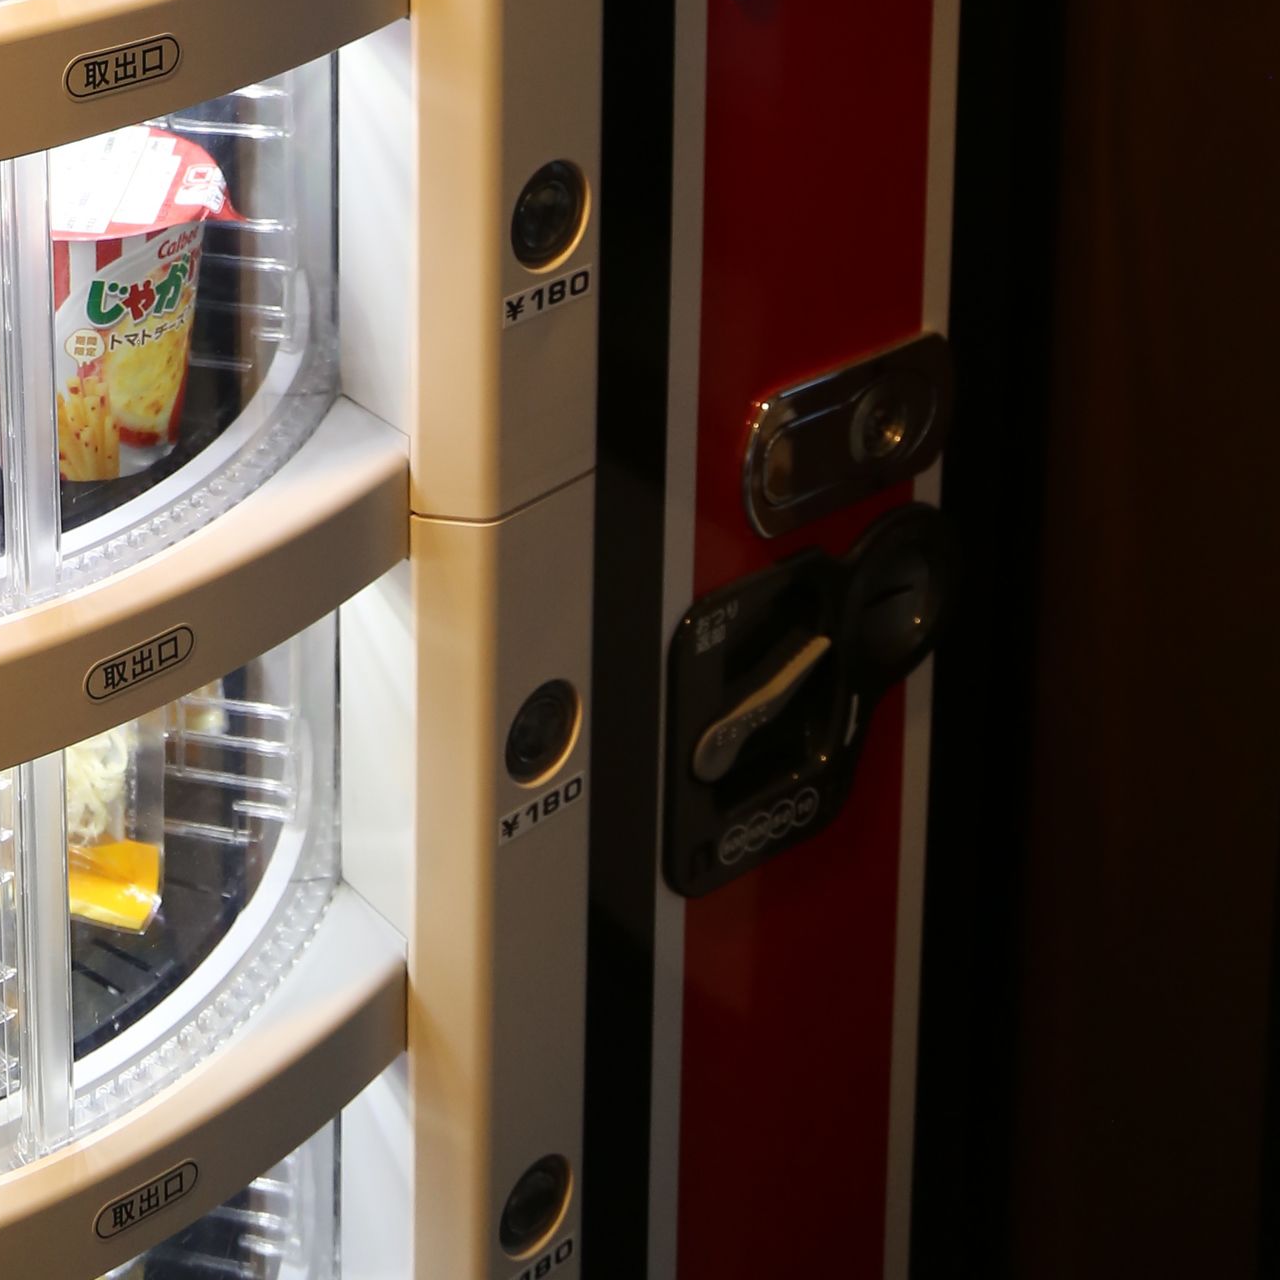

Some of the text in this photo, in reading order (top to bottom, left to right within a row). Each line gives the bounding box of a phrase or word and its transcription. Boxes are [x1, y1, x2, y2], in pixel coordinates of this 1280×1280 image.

[84, 43, 164, 91] 取出口
[506, 271, 590, 321] ¥180
[104, 635, 179, 690] 取出口
[501, 776, 583, 838] ¥180
[112, 1175, 185, 1230] 取出口
